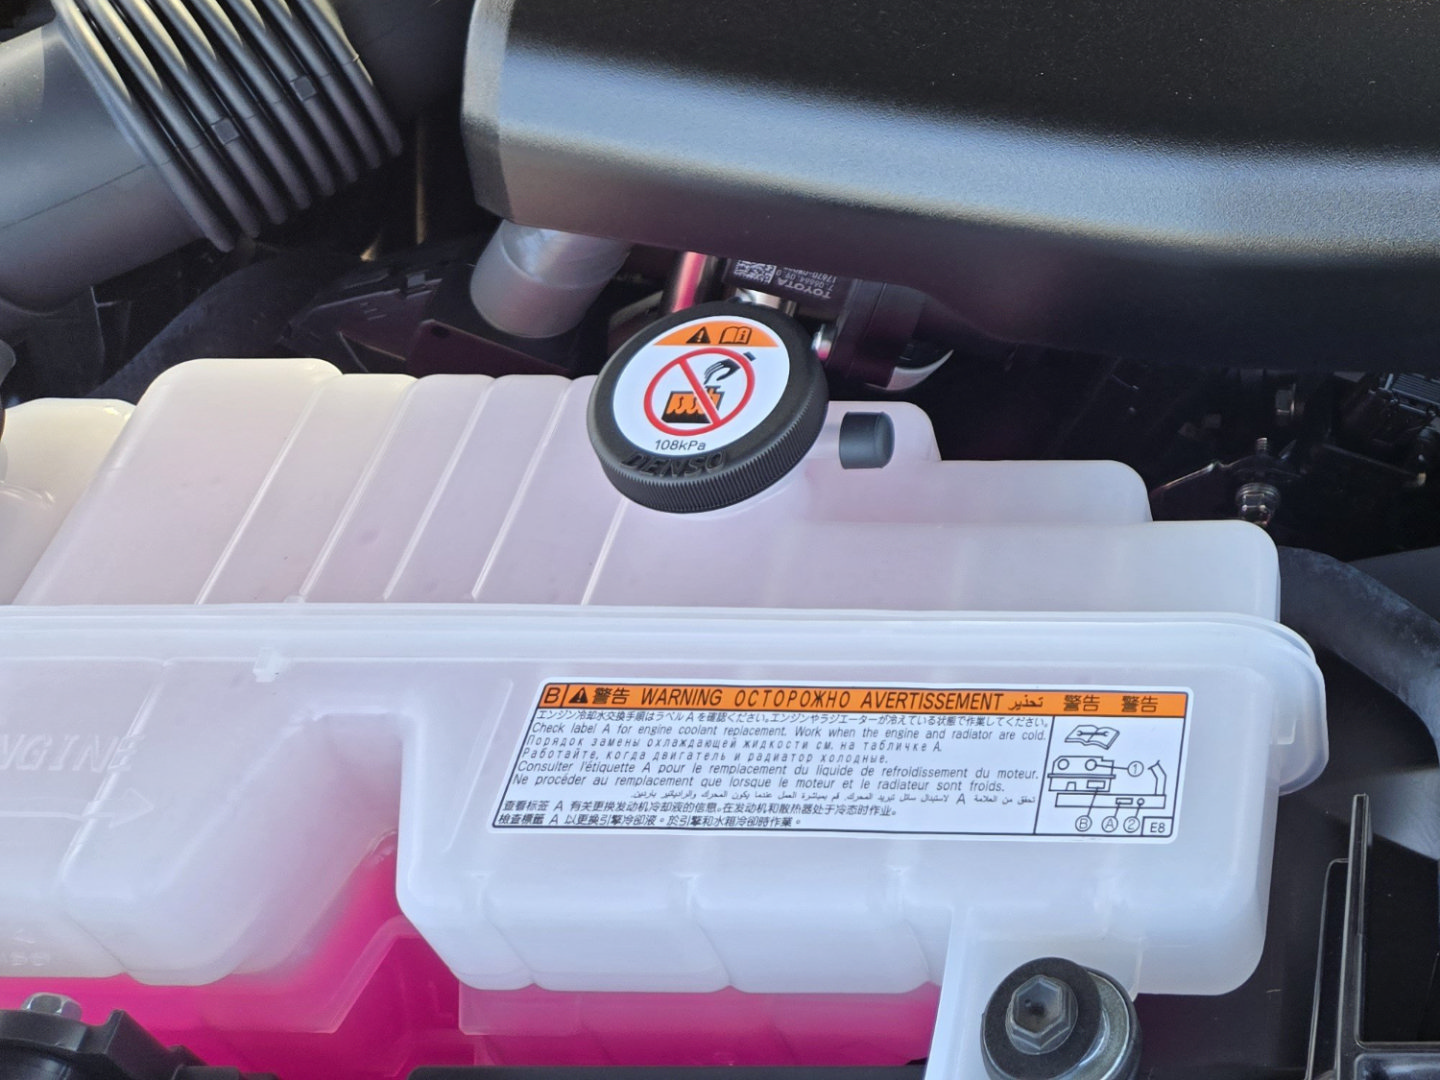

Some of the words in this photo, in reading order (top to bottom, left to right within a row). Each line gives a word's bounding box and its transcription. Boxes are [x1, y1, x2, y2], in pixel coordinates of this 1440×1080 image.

[776, 277, 832, 300] TOYOTA
[654, 438, 707, 452] 108kPa
[621, 451, 726, 478] DENSO
[544, 687, 561, 704] B
[592, 687, 630, 705] 警告
[641, 688, 723, 706] WARNING
[734, 689, 851, 709] ОСТОРОЖНО
[860, 691, 1004, 710] AVERTISSEMENT
[1008, 694, 1043, 711] تحذير
[1063, 695, 1100, 712] 警告
[1121, 696, 1158, 713] 警告
[532, 722, 565, 733] Check
[571, 723, 597, 734] label
[602, 723, 610, 734] A
[617, 724, 633, 734] for
[638, 724, 673, 736] engine
[678, 725, 718, 736] coolant
[723, 726, 787, 736] replacement.
[795, 726, 822, 737] Work
[828, 727, 856, 738] when
[862, 728, 879, 738] the
[885, 728, 920, 740] engine
[925, 729, 946, 739] and
[952, 729, 993, 740] radiator
[999, 731, 1016, 740] are
[1021, 730, 1046, 741] cold.
[526, 734, 584, 747] Порядок
[591, 738, 640, 747] замены
[647, 737, 737, 749] охлаждающей
[743, 740, 809, 750] жидкости
[840, 742, 855, 750] на
[864, 739, 927, 752] табличке
[606, 751, 646, 761] когда
[652, 751, 726, 761] двигатель
[734, 753, 741, 761] и
[747, 753, 813, 763] радиатор
[820, 754, 888, 764] холодные.
[518, 760, 574, 772] Consulter
[641, 762, 651, 773] A
[657, 764, 686, 774] pour
[692, 763, 702, 774] le
[709, 764, 787, 775] remplacement
[794, 764, 809, 775] du
[816, 765, 854, 776] liquide
[860, 765, 875, 777] de
[882, 765, 968, 778] refroidissement
[975, 768, 990, 779] du
[997, 769, 1038, 779] moteur.
[513, 774, 529, 785] Ne
[534, 774, 587, 786] procéder
[592, 777, 609, 786] au
[614, 775, 694, 787] remplacement
[700, 778, 722, 788] que
[729, 777, 772, 788] lorsque
[778, 777, 789, 788] le
[795, 778, 835, 789] moteur
[842, 779, 854, 789] et
[860, 779, 871, 789] le
[877, 779, 929, 791] radiateur
[936, 781, 962, 791] sont
[970, 780, 1005, 792] froids.
[553, 800, 563, 811] A
[956, 793, 966, 805] A
[548, 814, 558, 824] A
[1150, 822, 1166, 833] E8
